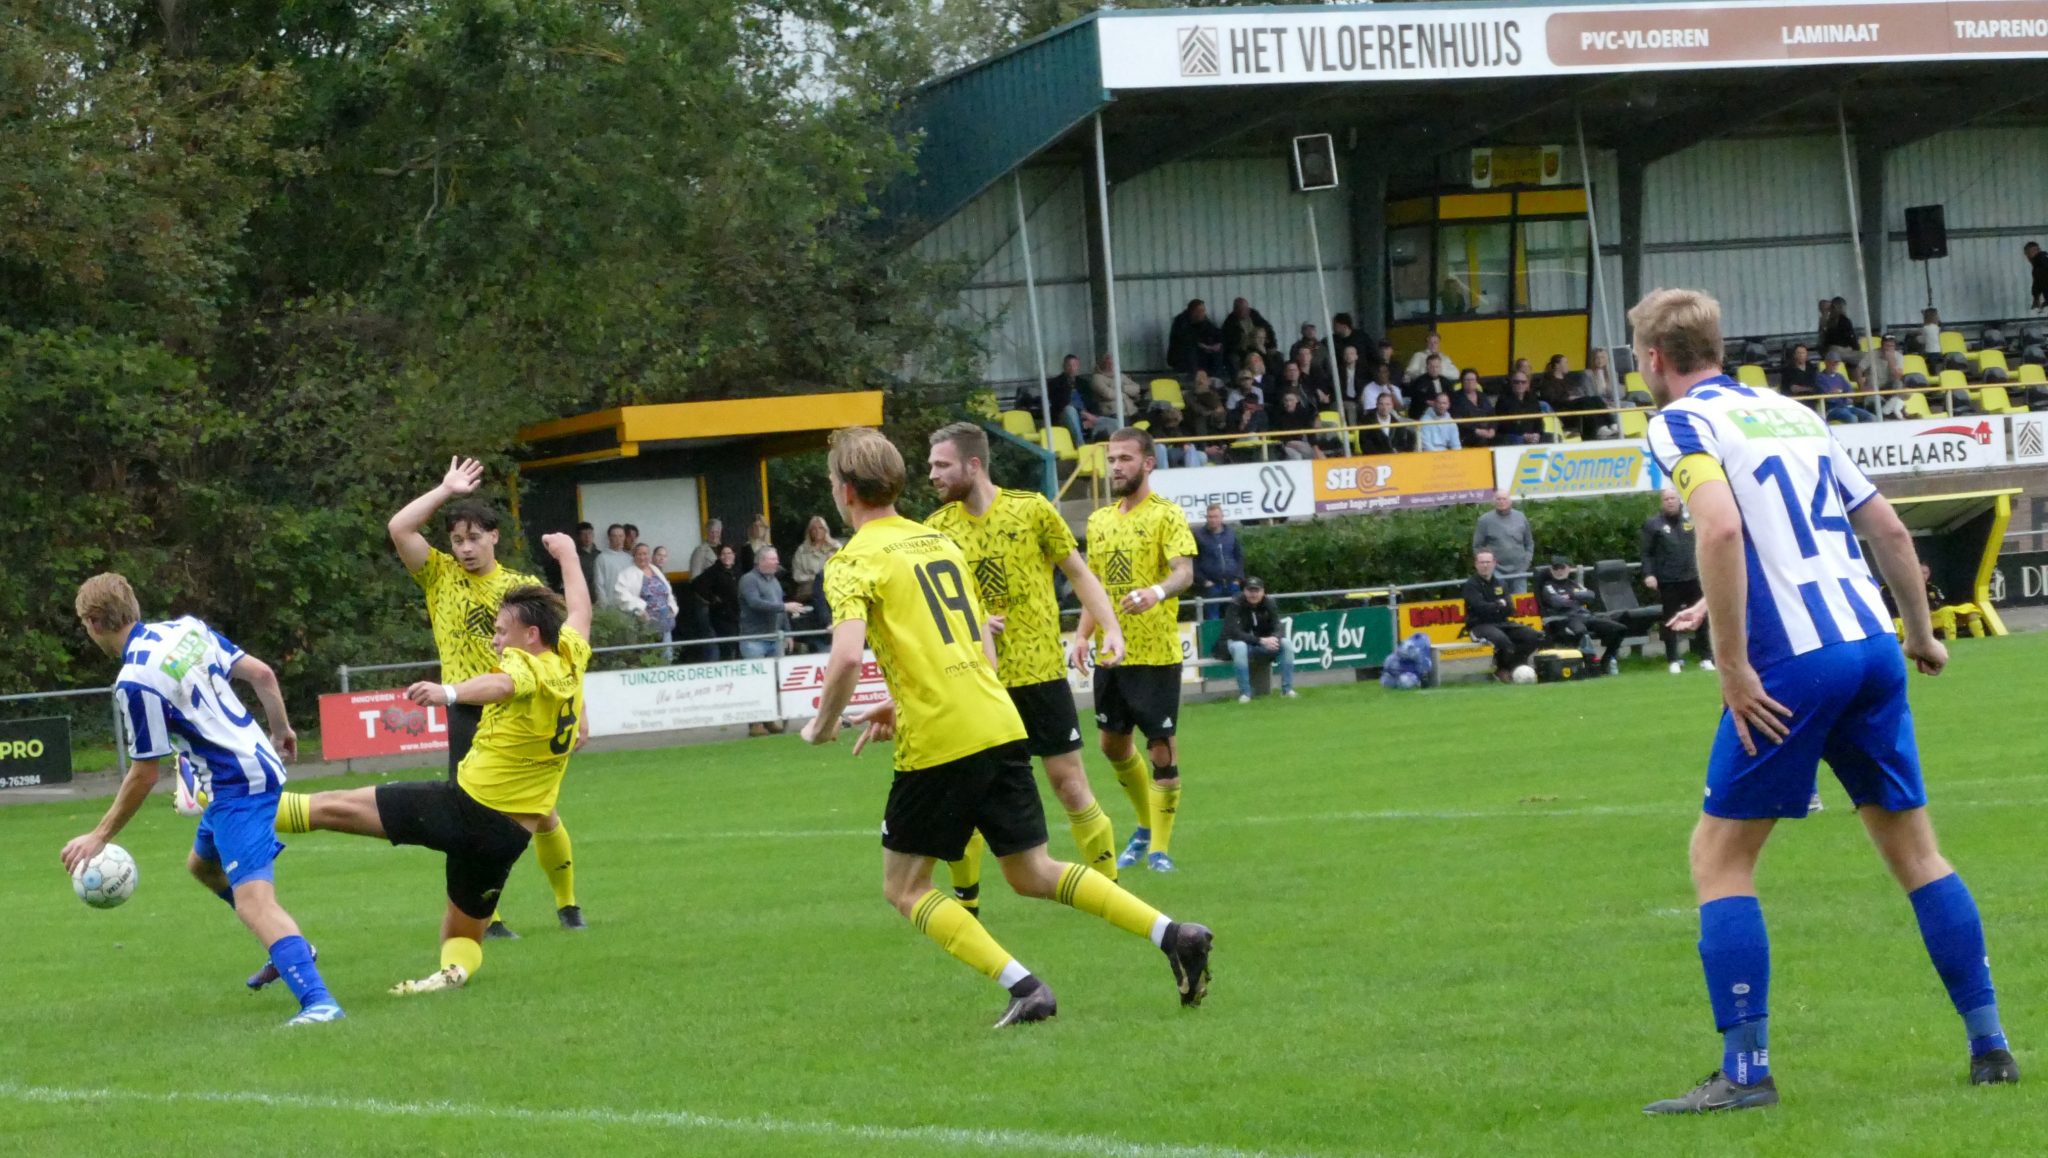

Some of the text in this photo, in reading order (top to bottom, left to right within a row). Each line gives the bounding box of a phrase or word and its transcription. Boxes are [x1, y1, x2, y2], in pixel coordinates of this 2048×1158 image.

[1230, 20, 1523, 74] HET VLOERENHUIJS
[1581, 28, 1710, 51] PVC-VLOEREN
[1781, 23, 1880, 45] LAMINAAT
[1550, 452, 1636, 483] Sommer
[1678, 468, 1691, 490] C
[1752, 454, 1862, 560] 14
[914, 559, 982, 645] 19
[1337, 612, 1366, 648] bv
[0, 738, 44, 760] PRO
